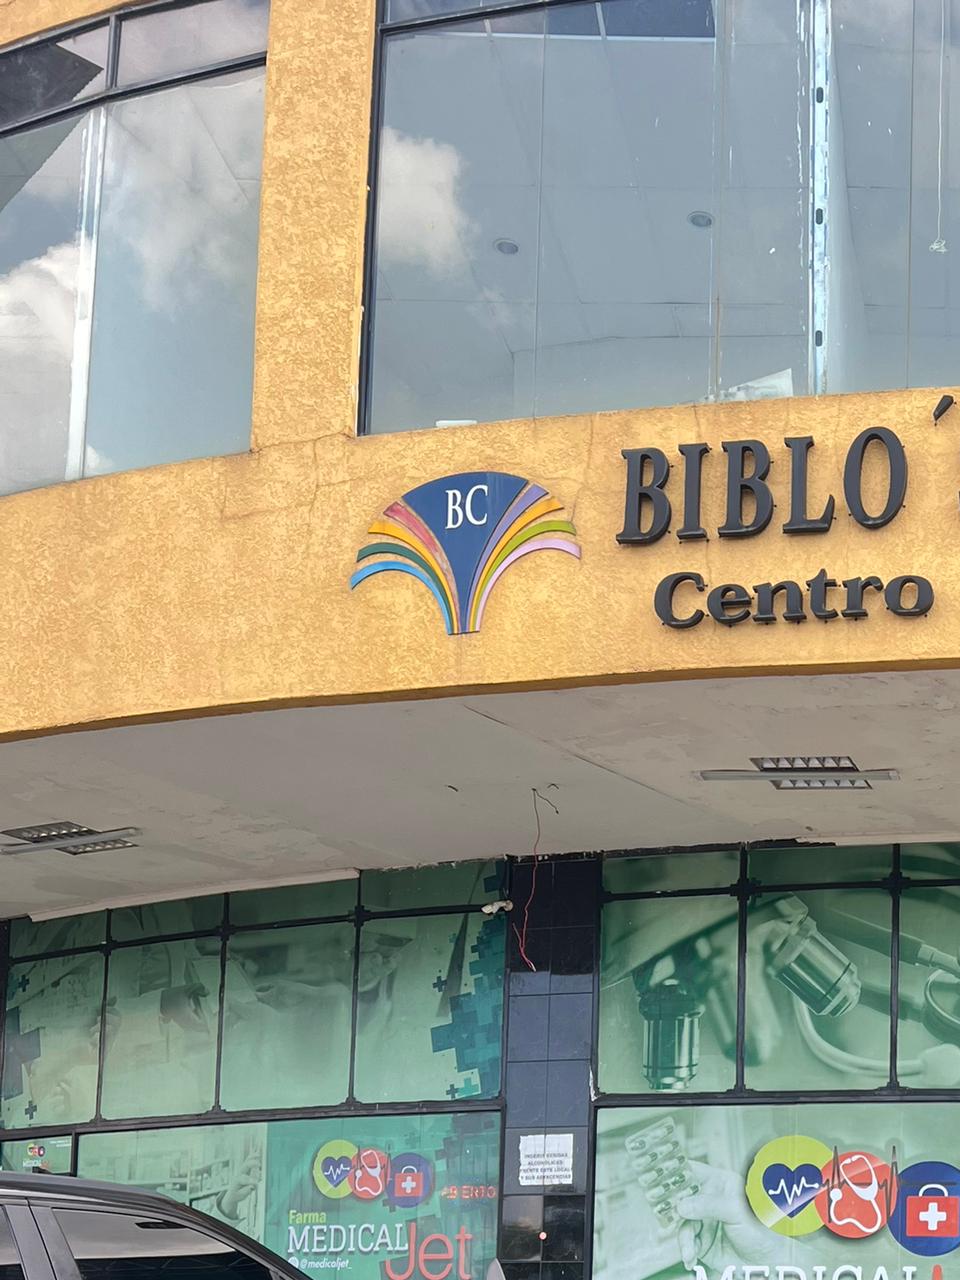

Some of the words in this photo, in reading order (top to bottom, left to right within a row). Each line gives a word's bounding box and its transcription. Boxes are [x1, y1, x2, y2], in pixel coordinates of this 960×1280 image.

[445, 484, 489, 530] BC
[653, 568, 935, 630] Centro
[288, 1209, 327, 1224] Farma
[287, 1223, 409, 1254] MEDICAL
